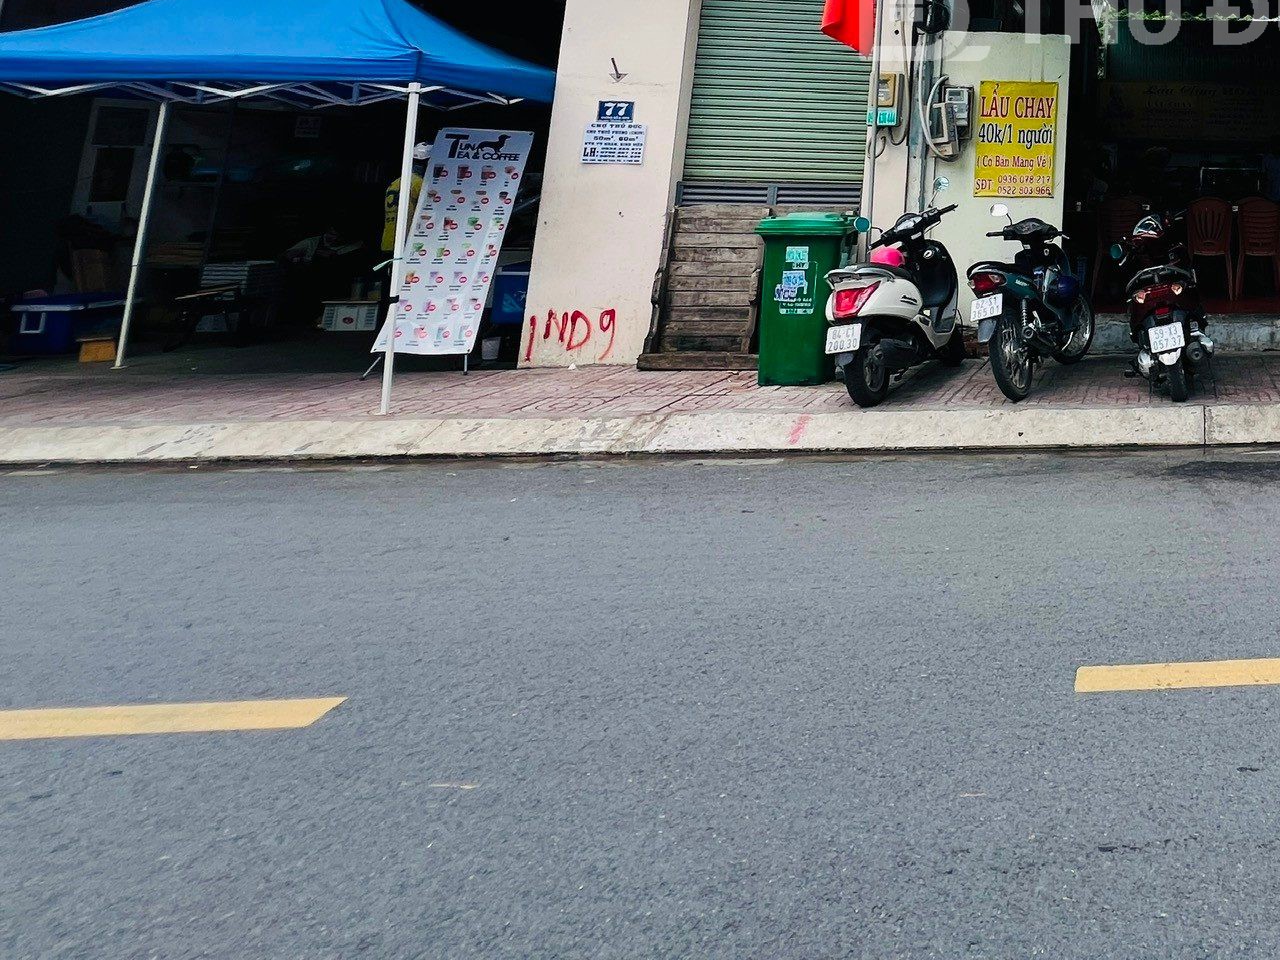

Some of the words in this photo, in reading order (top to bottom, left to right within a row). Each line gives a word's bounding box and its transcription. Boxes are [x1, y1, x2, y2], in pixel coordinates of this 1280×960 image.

[981, 83, 1010, 118] LẨU
[1014, 96, 1055, 119] CHAY
[603, 102, 630, 117] 77
[979, 123, 1012, 146] 40k/1
[1018, 123, 1053, 150] người
[482, 152, 521, 162] COFFEE
[1012, 155, 1034, 171] Mang
